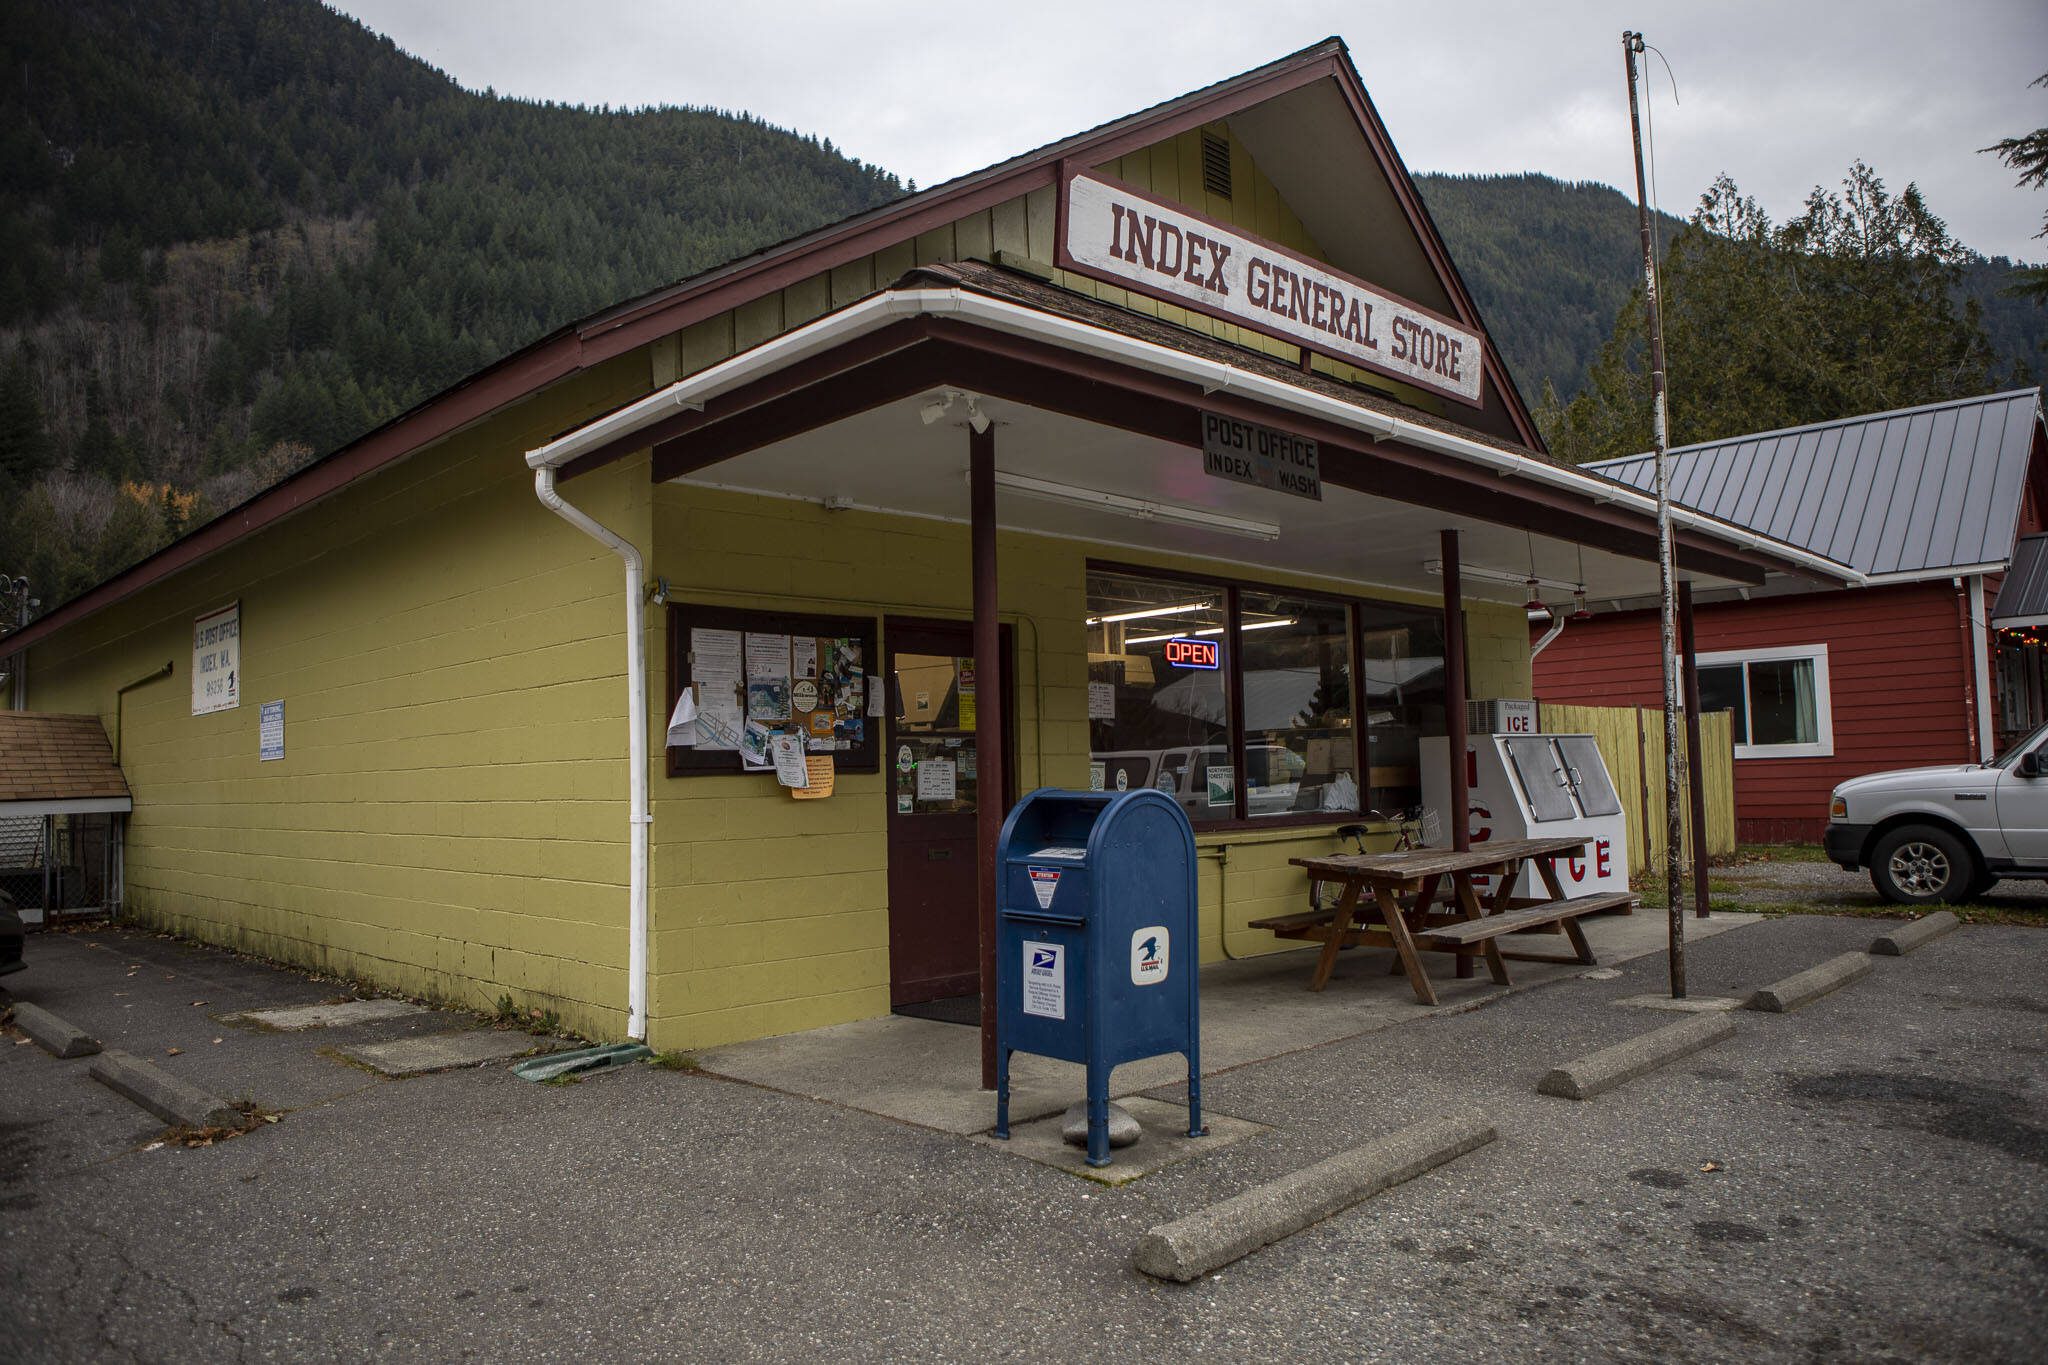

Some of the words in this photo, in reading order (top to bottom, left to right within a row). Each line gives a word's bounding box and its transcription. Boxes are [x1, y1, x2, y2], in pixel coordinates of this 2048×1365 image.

[1109, 202, 1232, 296] INDEX
[1247, 256, 1378, 350] GENERAL
[1391, 316, 1464, 382] STORE
[1206, 415, 1253, 452] POST
[1258, 430, 1316, 469] OFFICE
[1208, 452, 1254, 480] INDEX
[1278, 470, 1318, 497] WASH
[205, 626, 219, 647] POST
[219, 618, 237, 641] OFFICE
[1166, 642, 1215, 664] OPEN
[1506, 715, 1529, 732] ICE
